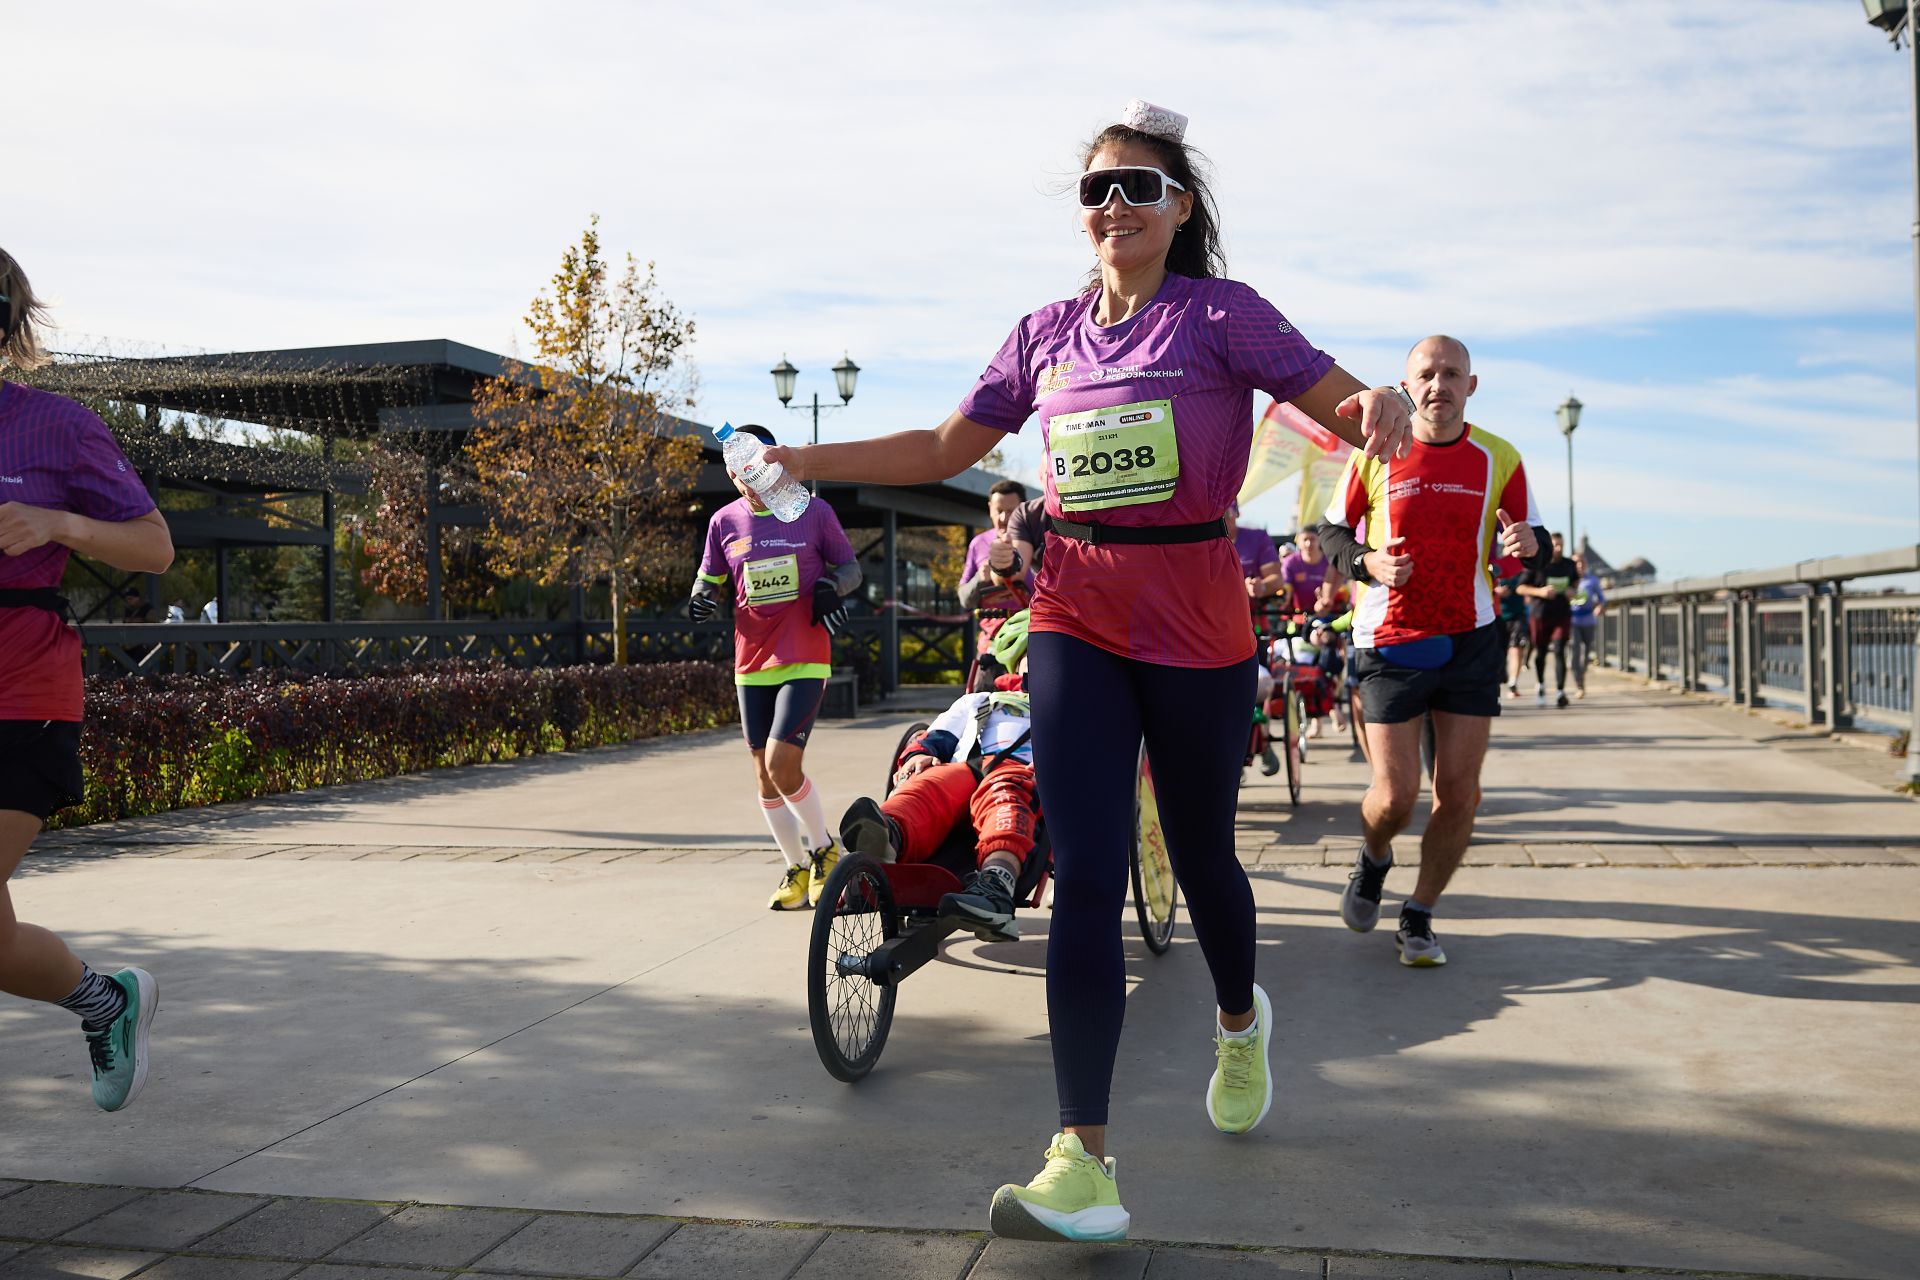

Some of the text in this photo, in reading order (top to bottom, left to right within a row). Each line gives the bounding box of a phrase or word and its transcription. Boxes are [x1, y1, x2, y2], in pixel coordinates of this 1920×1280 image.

[1072, 446, 1156, 477] 2038
[0, 475, 23, 485] НЫЙ
[752, 575, 790, 590] 2442
